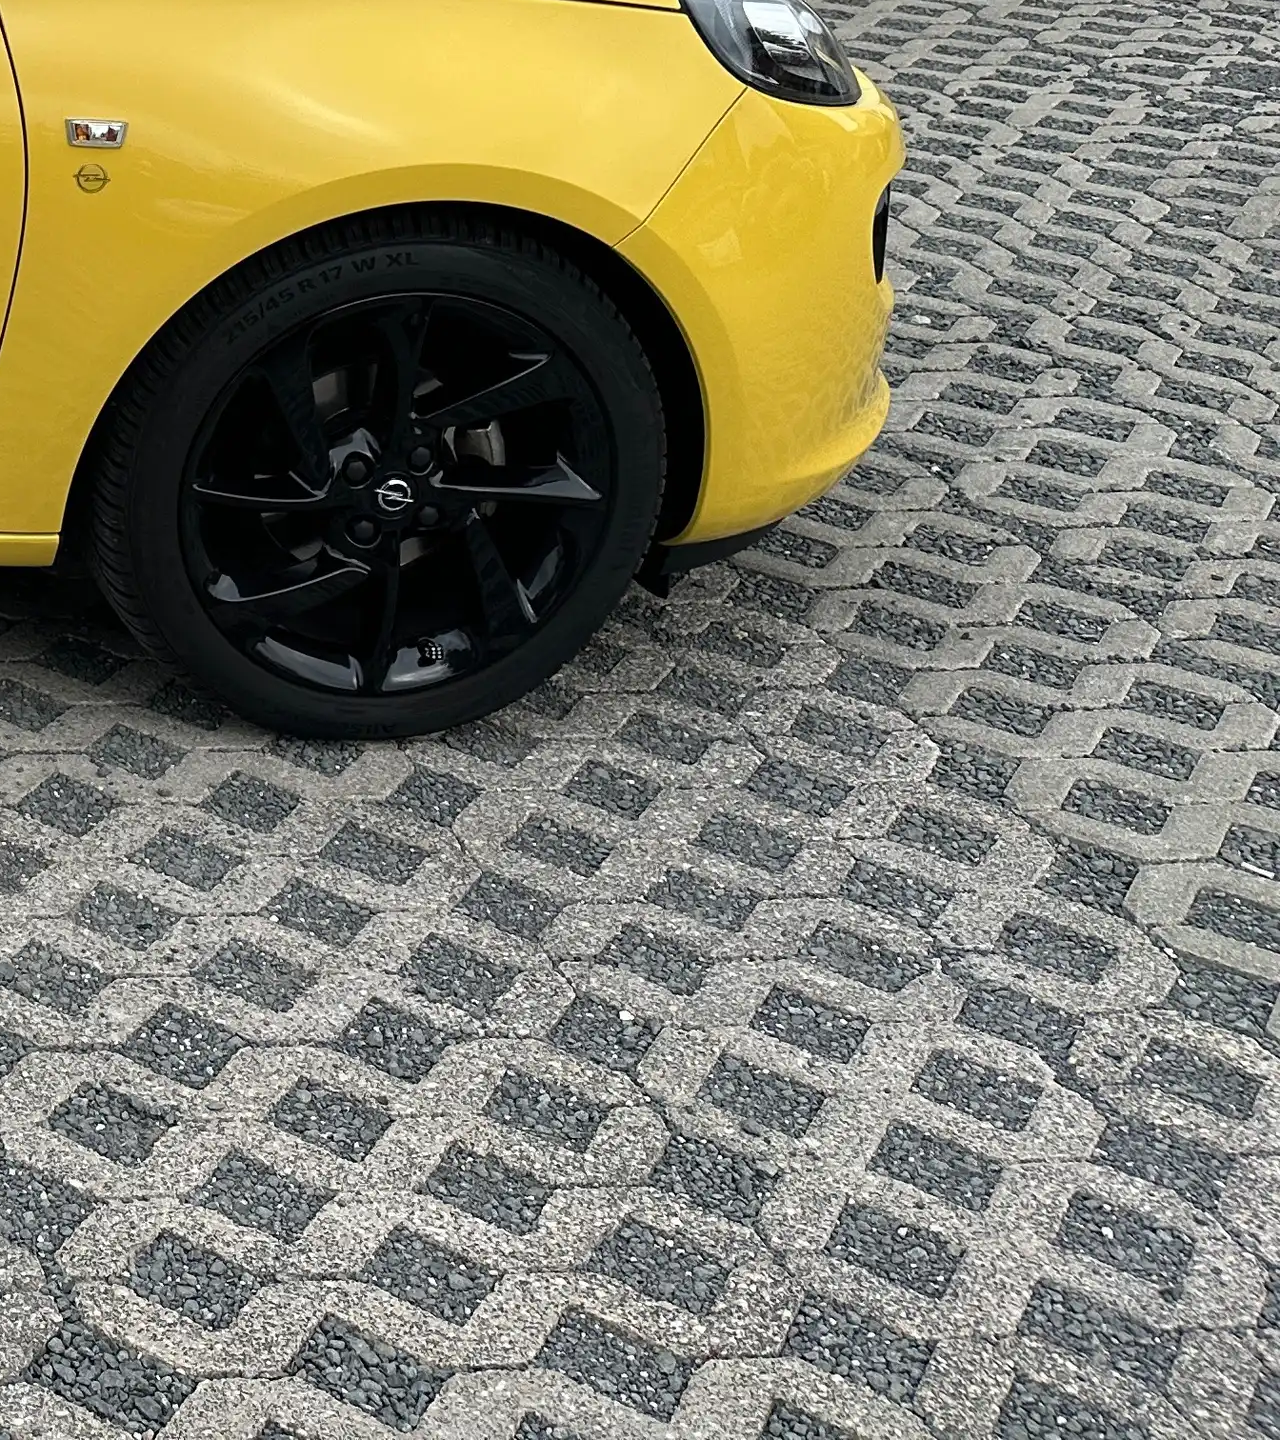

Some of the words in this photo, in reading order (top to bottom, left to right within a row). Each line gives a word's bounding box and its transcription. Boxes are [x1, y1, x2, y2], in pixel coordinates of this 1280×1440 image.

[296, 278, 318, 293] R
[318, 265, 343, 284] 17
[351, 257, 376, 273] W
[385, 252, 421, 267] XL
